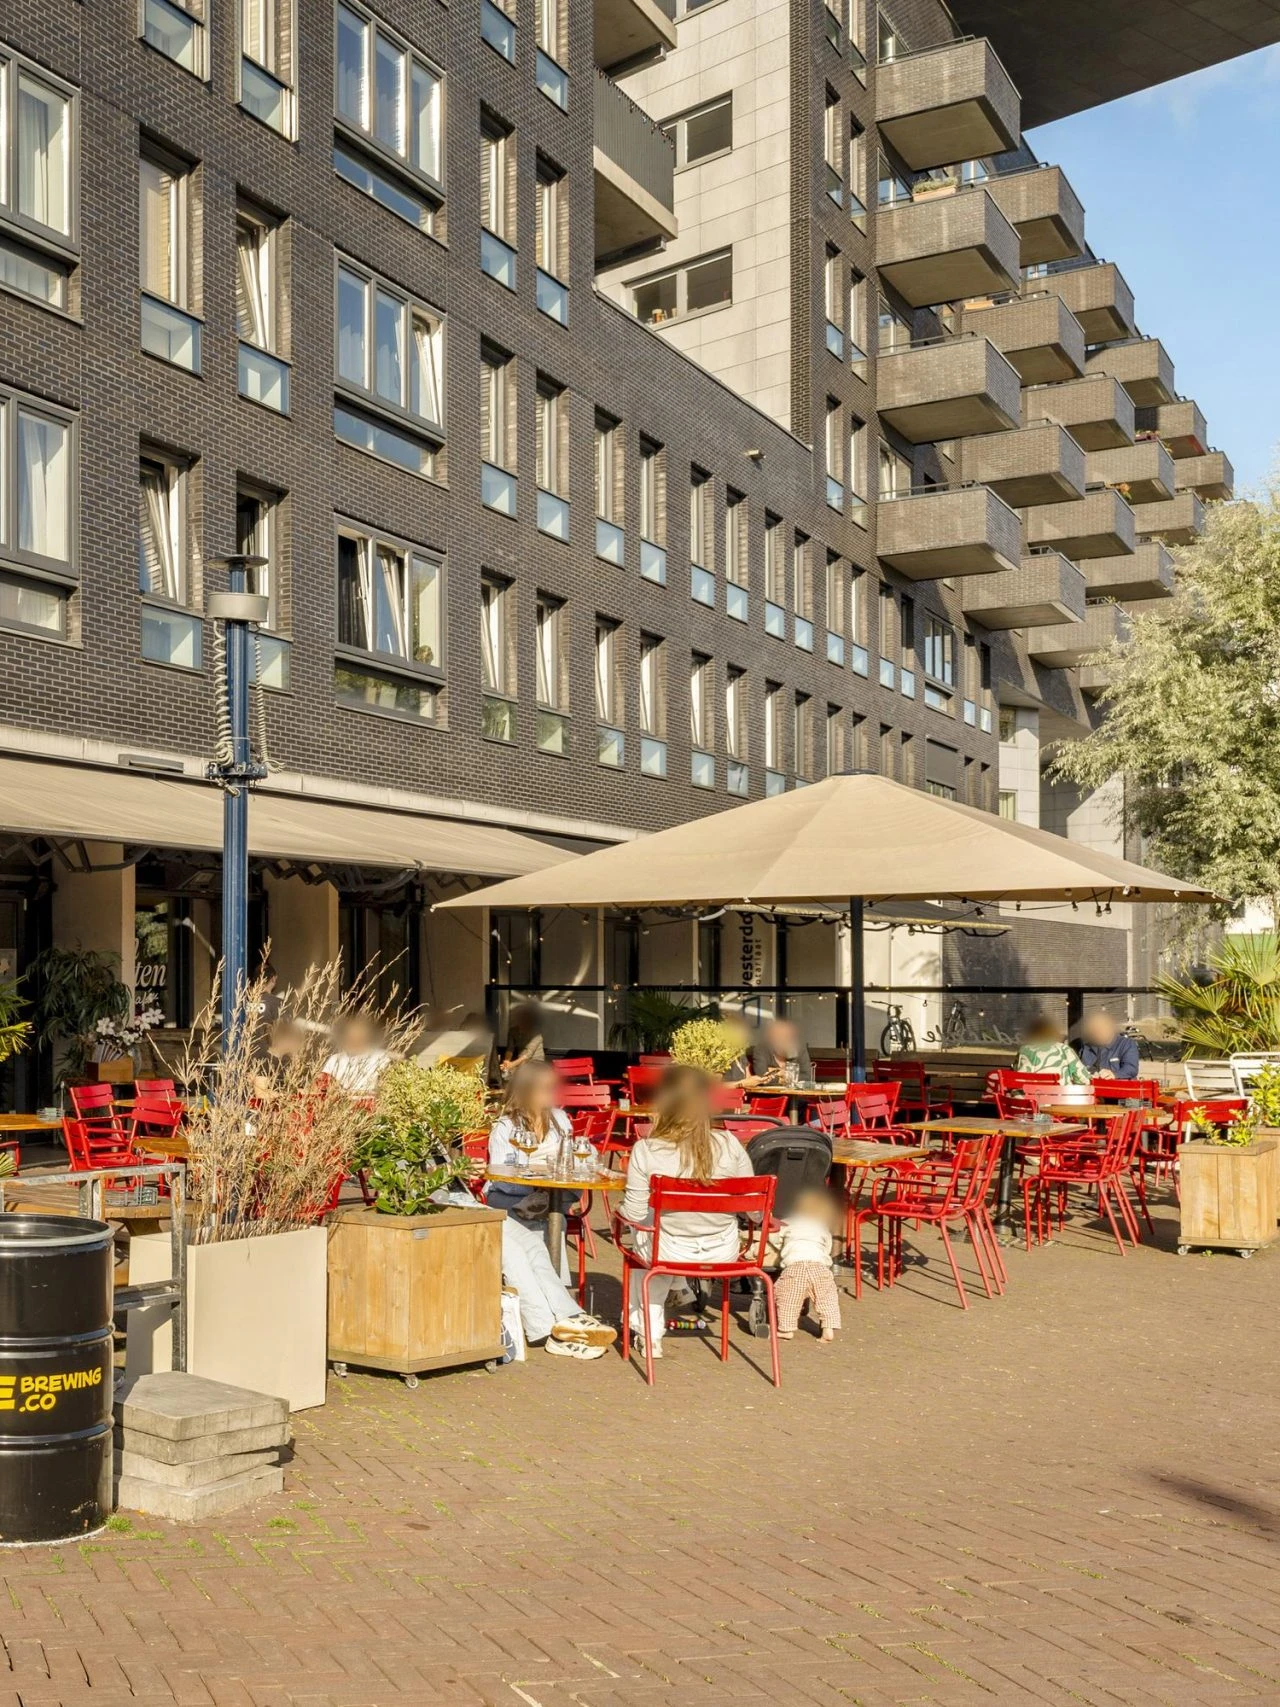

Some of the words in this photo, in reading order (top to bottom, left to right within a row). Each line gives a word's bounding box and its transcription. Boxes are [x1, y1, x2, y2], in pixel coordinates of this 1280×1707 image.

[739, 912, 754, 987] esterdo
[135, 961, 167, 987] ten
[20, 1367, 102, 1394] BREWING
[19, 1393, 57, 1413] .CO
